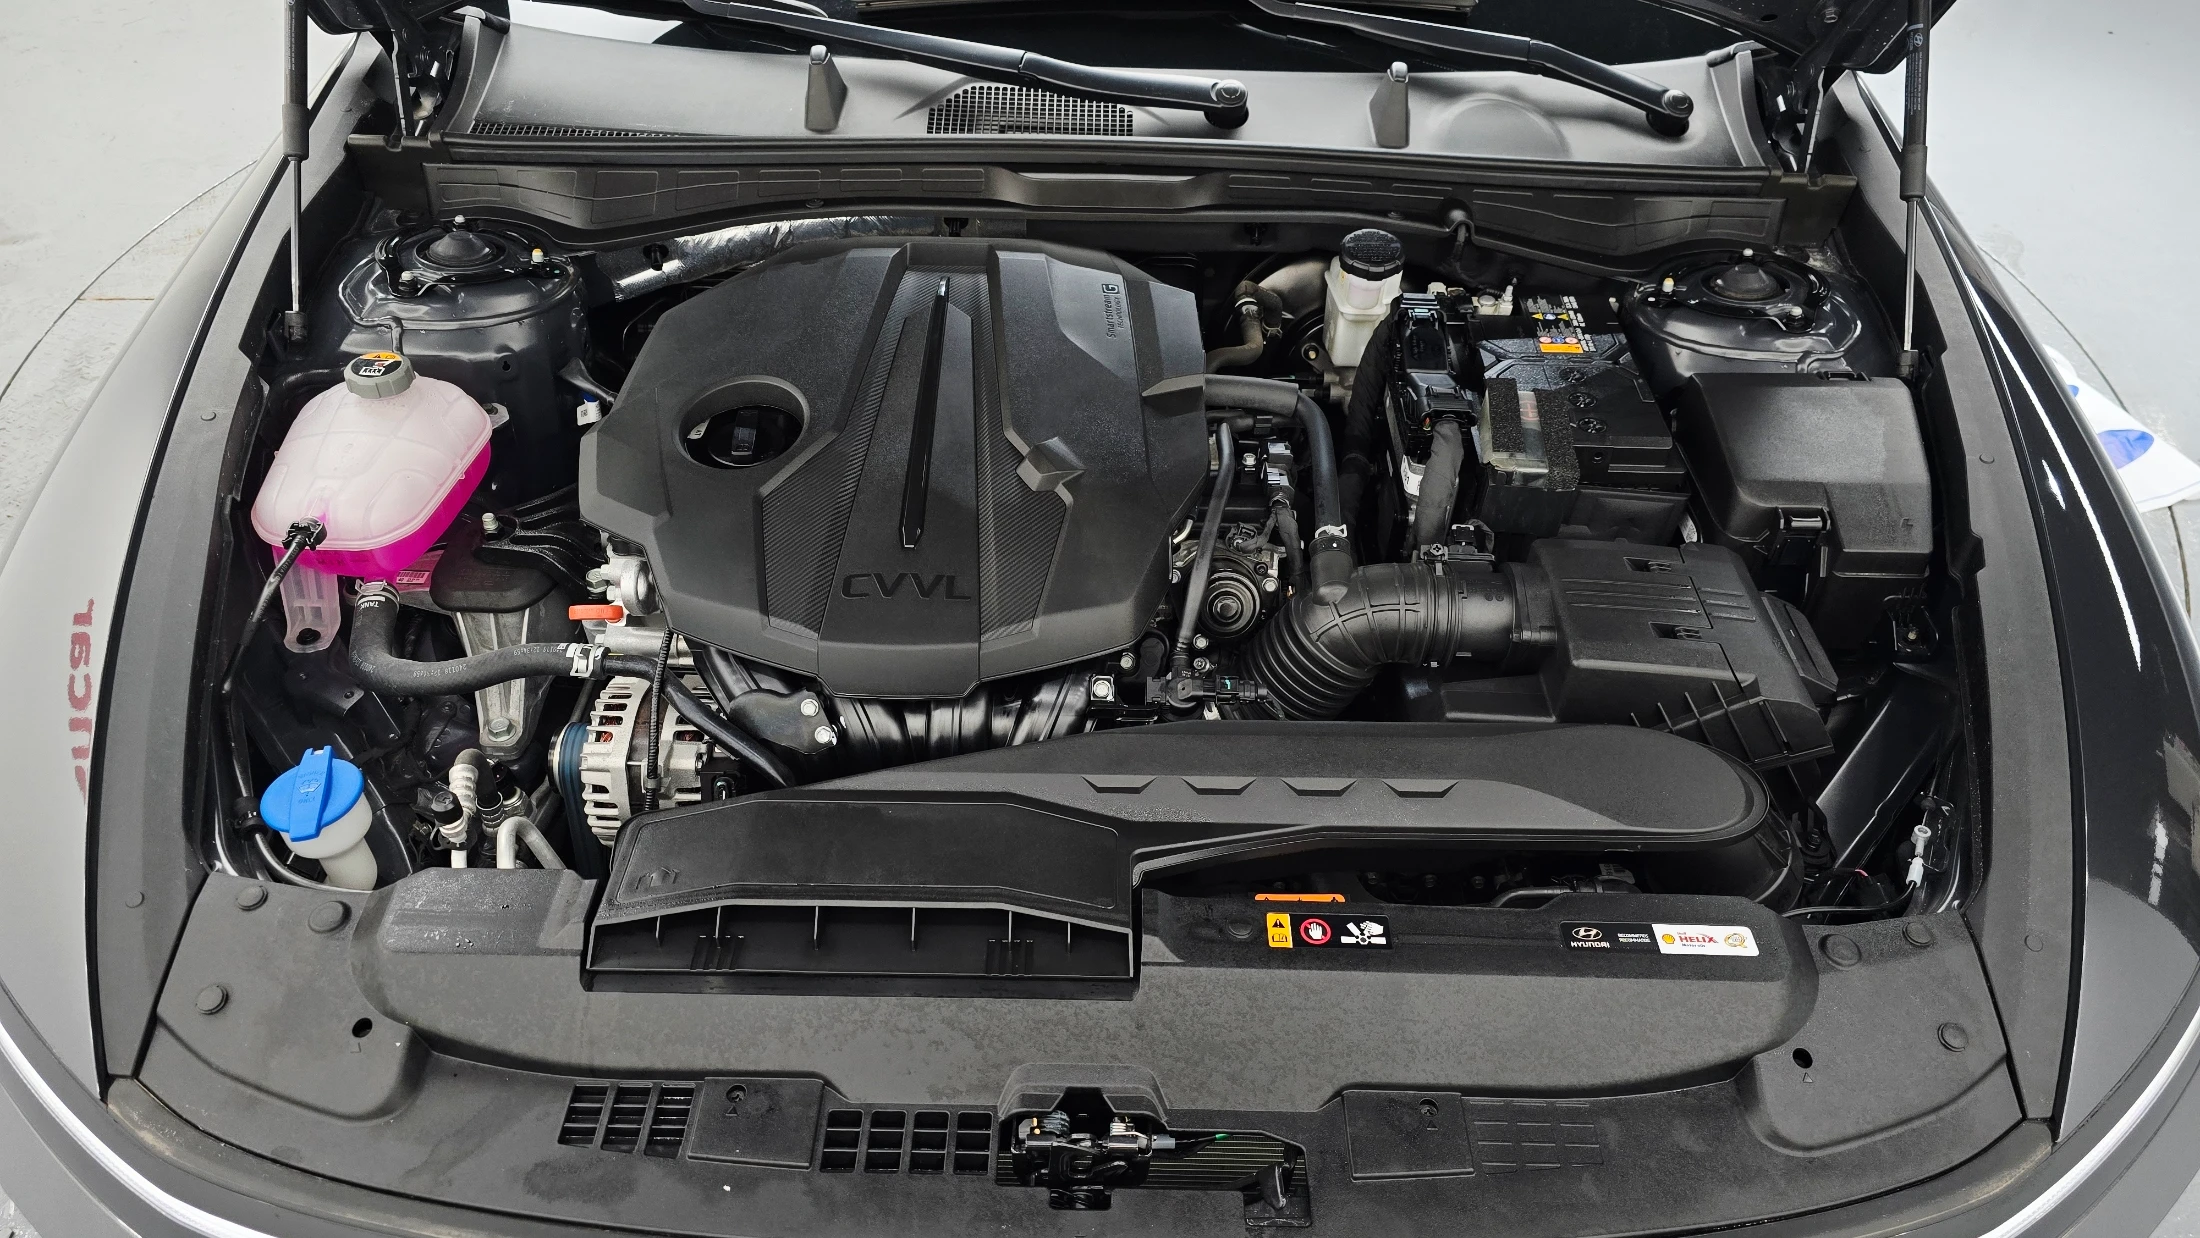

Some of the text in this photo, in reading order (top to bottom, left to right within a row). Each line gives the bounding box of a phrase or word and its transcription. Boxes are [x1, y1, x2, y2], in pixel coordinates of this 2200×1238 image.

[1104, 294, 1116, 339] Smartstream
[841, 572, 972, 601] CVVL
[359, 601, 380, 609] TANK
[1679, 934, 1719, 944] HELIX
